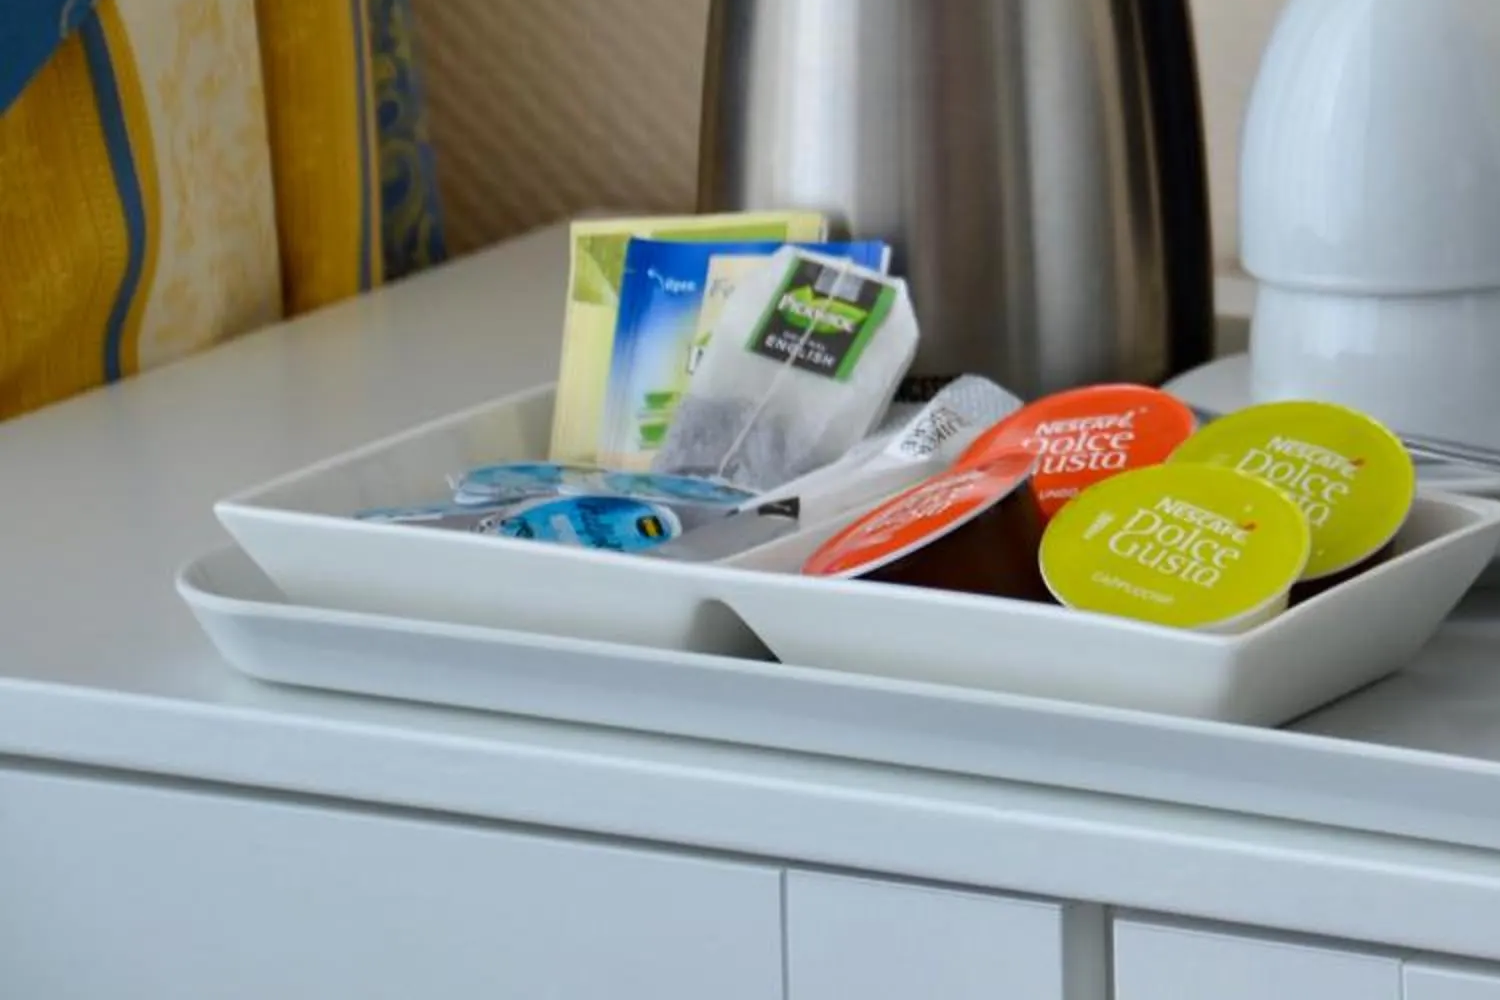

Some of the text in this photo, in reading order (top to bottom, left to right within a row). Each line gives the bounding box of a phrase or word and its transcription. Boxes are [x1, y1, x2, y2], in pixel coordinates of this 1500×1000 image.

[1031, 450, 1128, 475] usto
[1235, 448, 1350, 504] Dolce
[1108, 530, 1221, 589] Gusto
[1122, 507, 1241, 569] Dolce
